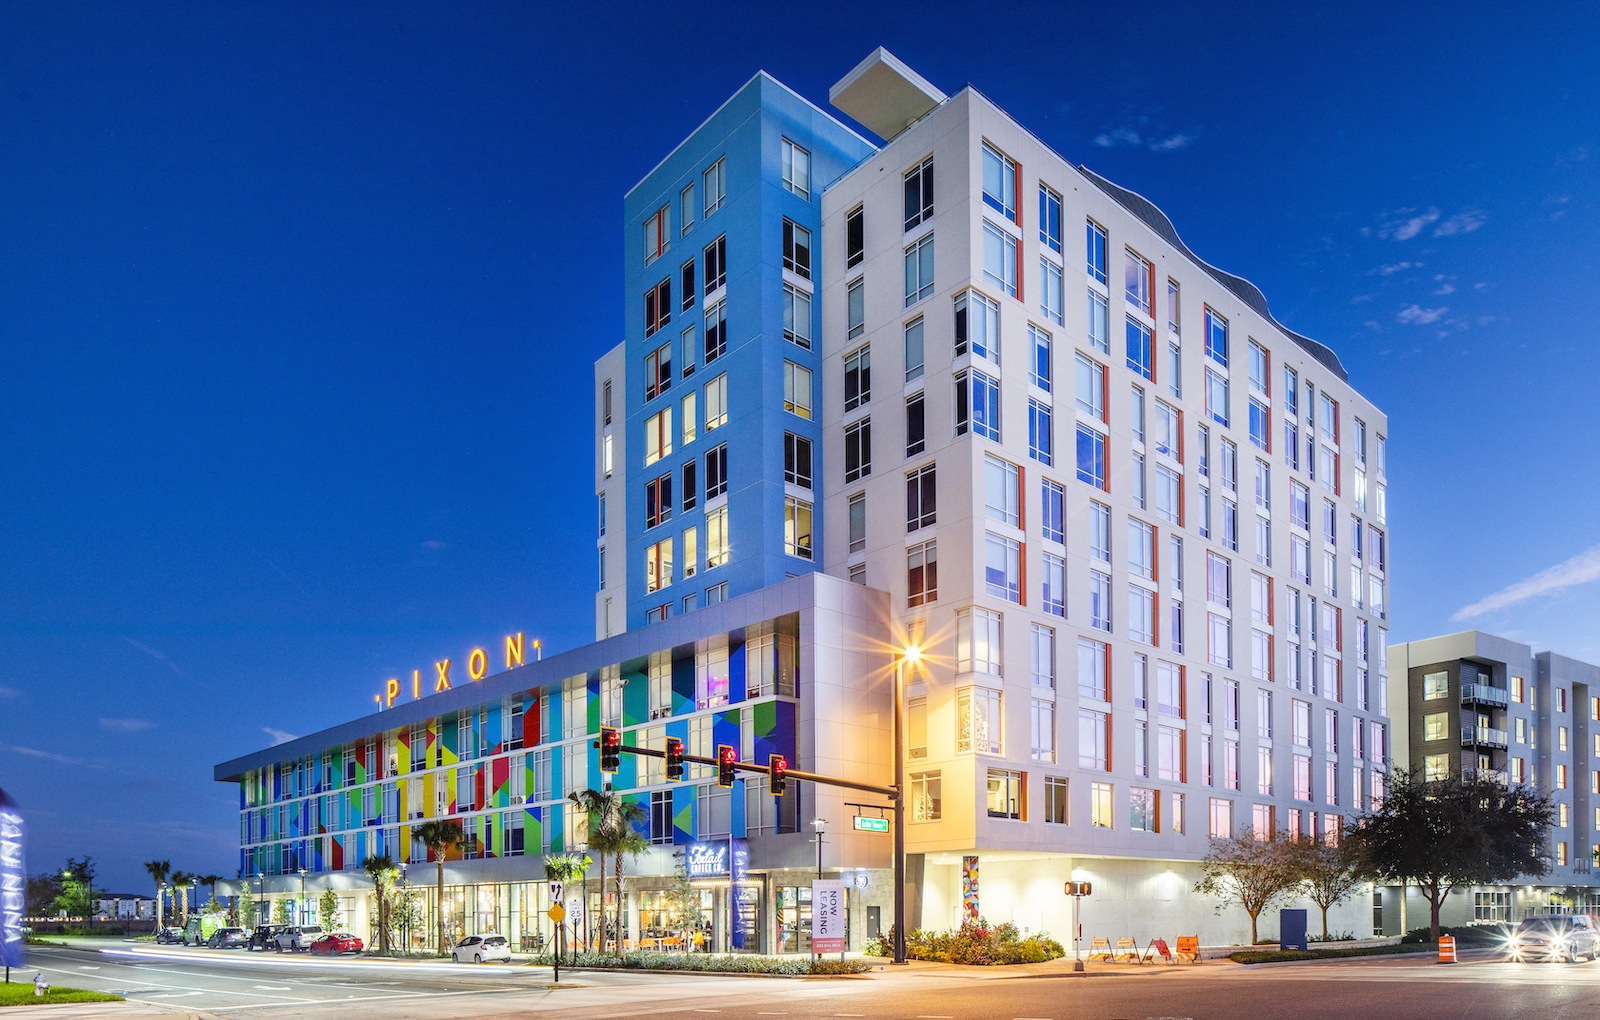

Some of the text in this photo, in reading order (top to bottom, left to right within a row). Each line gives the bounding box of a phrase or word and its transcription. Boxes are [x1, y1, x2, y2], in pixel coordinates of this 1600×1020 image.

[386, 632, 525, 708] PIXON
[690, 864, 713, 874] COFFEE
[820, 891, 828, 935] LEASING
